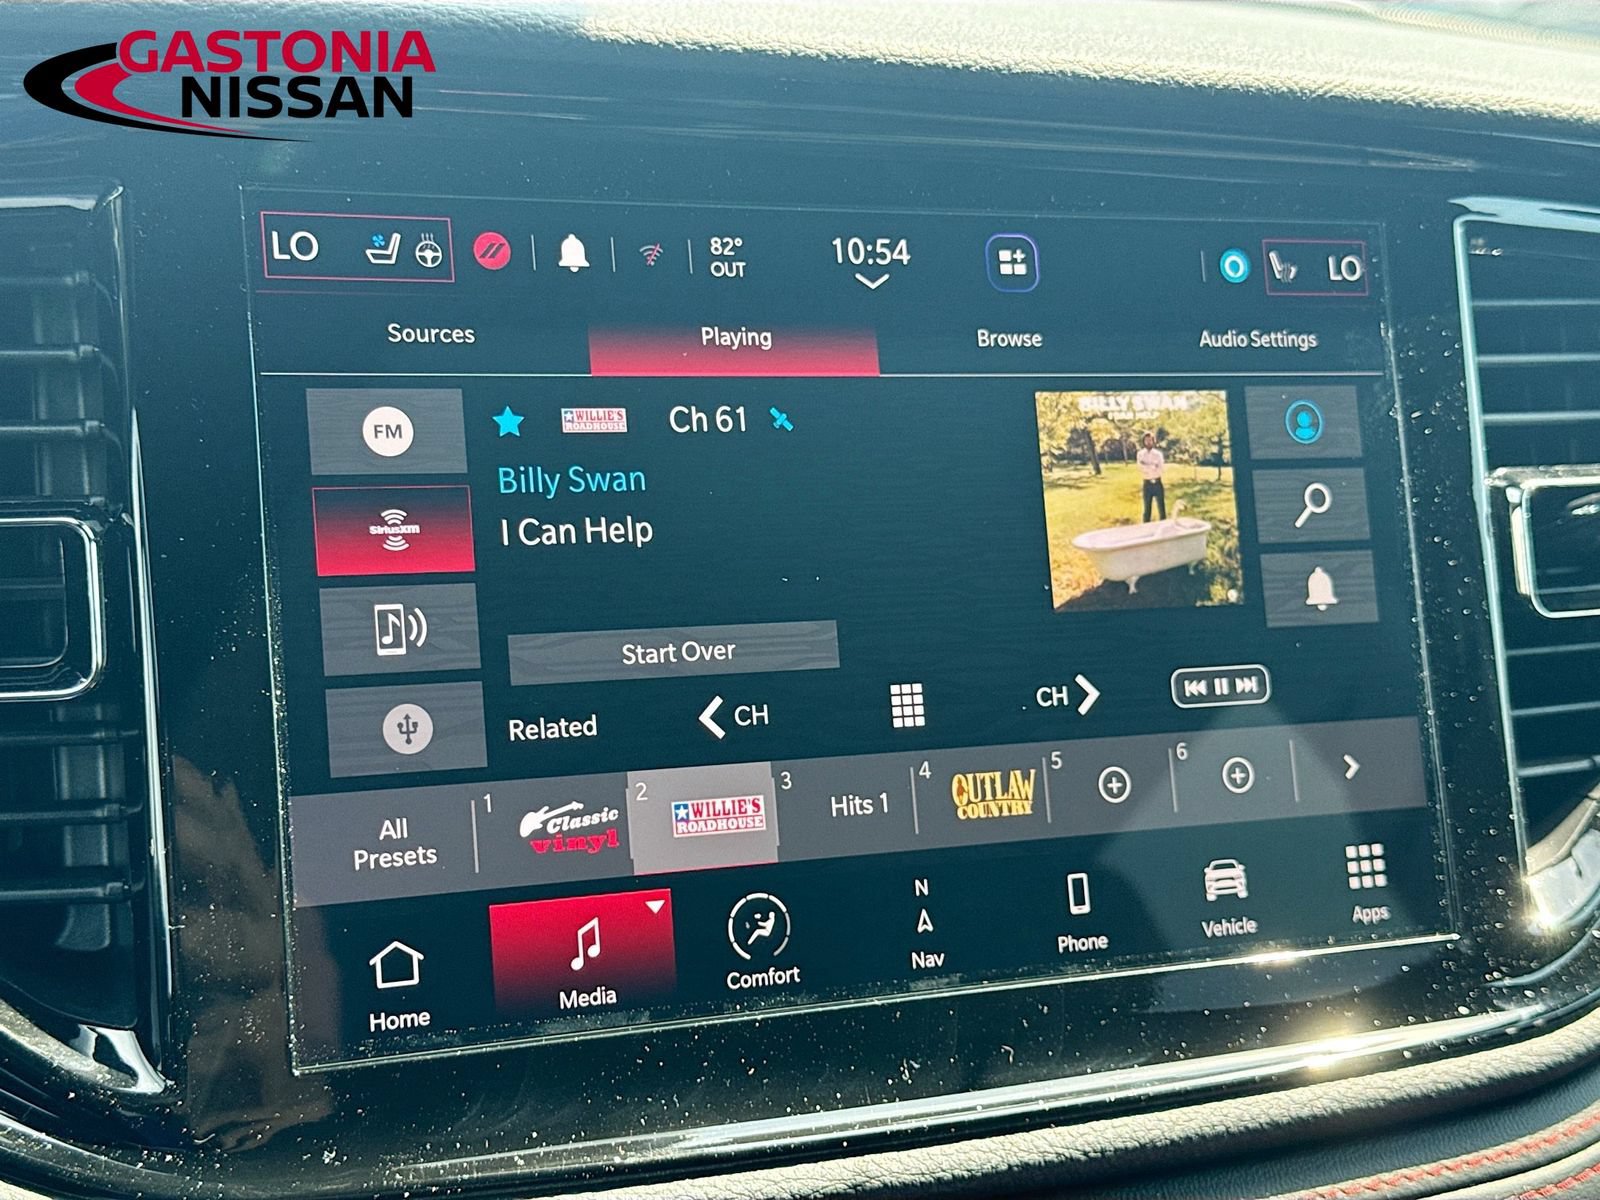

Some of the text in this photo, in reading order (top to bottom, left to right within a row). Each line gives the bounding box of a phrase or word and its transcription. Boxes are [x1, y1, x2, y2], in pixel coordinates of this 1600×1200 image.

[271, 230, 319, 262] LO
[709, 236, 743, 257] 82°
[832, 237, 911, 266] 10:54
[710, 261, 746, 279] OUT
[1327, 255, 1363, 282] LO
[387, 322, 476, 345] Sources
[701, 326, 773, 352] Playing
[977, 328, 1043, 348] Browse
[1199, 328, 1318, 352] Audio Settings
[565, 421, 626, 431] ROADHOUSE
[575, 410, 624, 421] WILLIE'S
[669, 405, 747, 433] Ch 61
[373, 423, 403, 440] FM
[498, 464, 647, 500] Billy Swan
[500, 516, 654, 549] I Can Help
[621, 640, 736, 665] Start Over
[1035, 686, 1070, 708] CH
[733, 704, 770, 727] CH
[508, 714, 598, 742] Related
[1050, 751, 1062, 770] 5
[1175, 742, 1188, 761] 6
[780, 772, 793, 791] 3
[918, 760, 933, 780] 4
[635, 782, 649, 801] 2
[951, 768, 1036, 805] OUTLAW
[483, 792, 493, 813] 1
[691, 798, 762, 818] WILLIE'S
[830, 792, 890, 819] Hits 1
[956, 798, 1034, 821] COUNTRY
[379, 817, 410, 841] All
[546, 807, 620, 835] Classic
[676, 816, 764, 836] ROADHOUSE
[530, 828, 620, 854] vinyl
[353, 845, 438, 871] Presets
[914, 878, 929, 897] N
[1352, 904, 1391, 924] Apps
[1201, 915, 1258, 938] Vehicle
[1057, 932, 1109, 954] Phone
[911, 950, 945, 970] Nav
[726, 965, 801, 991] Comfort
[559, 985, 618, 1010] Media
[369, 1009, 431, 1033] Home
